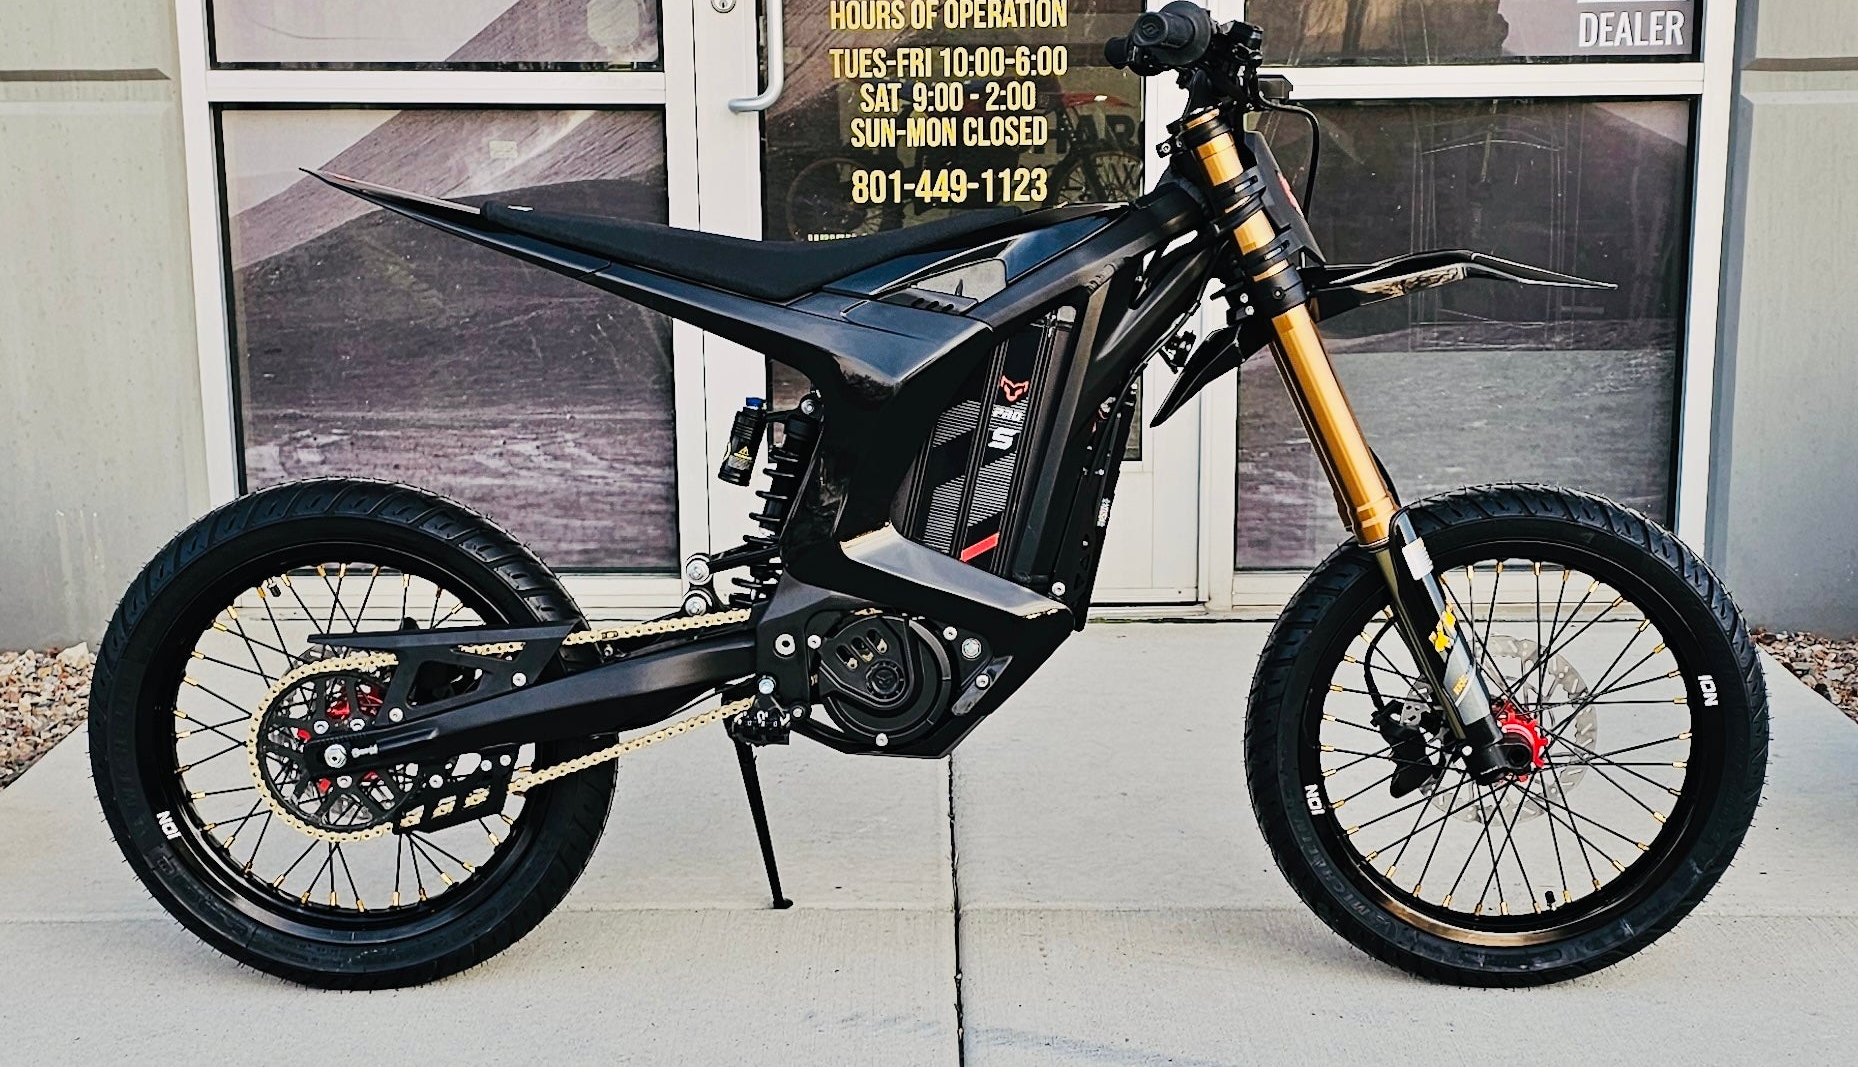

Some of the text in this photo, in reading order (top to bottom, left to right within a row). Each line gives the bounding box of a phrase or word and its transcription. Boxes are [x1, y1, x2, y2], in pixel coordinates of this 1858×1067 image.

[830, 0, 906, 30] HOURS
[1578, 9, 1685, 48] DEALER
[829, 45, 1068, 79] TUES-FRI 10:00-6:00
[859, 82, 902, 113] SAT
[912, 82, 964, 112] 9:00
[985, 81, 1037, 111] 2:00
[850, 116, 1048, 148] SUN-MON CLOSED
[851, 167, 1049, 204] 801-449-1123
[1697, 674, 1719, 707] ION
[1304, 783, 1326, 816] ION
[156, 810, 182, 840] ION
